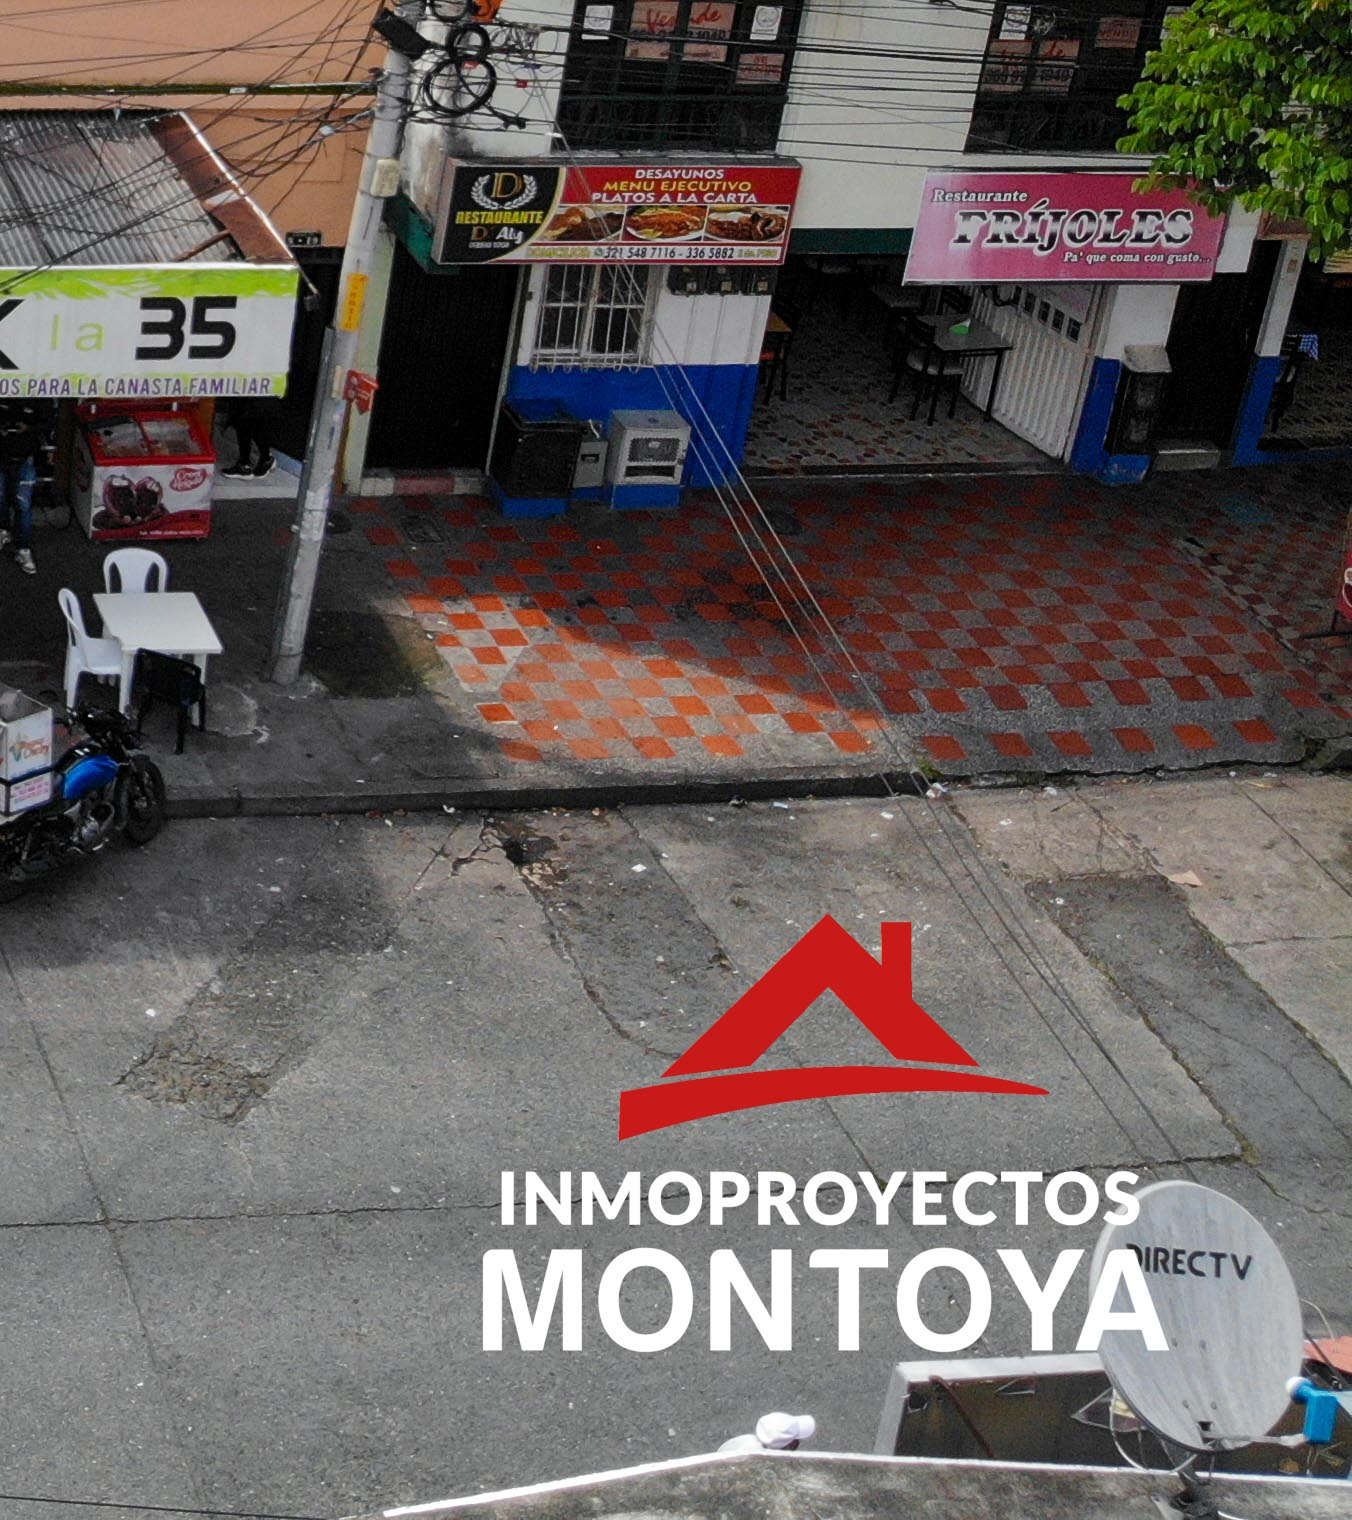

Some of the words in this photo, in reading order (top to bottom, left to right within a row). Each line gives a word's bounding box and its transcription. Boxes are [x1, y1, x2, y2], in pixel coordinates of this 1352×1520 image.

[635, 169, 725, 180] DESAYUNOS
[660, 181, 752, 192] EJECUTIVO
[592, 192, 655, 204] PLATOS
[659, 193, 673, 204] A
[677, 193, 698, 204] LA
[703, 193, 758, 204] CARTA
[932, 189, 1029, 203] Restaurante
[455, 210, 544, 225] RESTAURANTE
[949, 199, 1194, 257] FRÍJOLES
[496, 226, 524, 245] Aly
[604, 247, 623, 259] 321
[627, 247, 647, 258] 548
[650, 247, 676, 258] 7116
[686, 247, 706, 258] 336
[708, 247, 735, 258] 5882
[1086, 253, 1107, 265] que
[1110, 253, 1140, 262] coma
[1144, 254, 1164, 262] con
[50, 313, 105, 351] la
[135, 296, 238, 360] 35
[27, 378, 71, 395] PARA
[78, 378, 97, 395] LA
[104, 378, 182, 395] CANASTA
[188, 378, 271, 395] FAMILIAR
